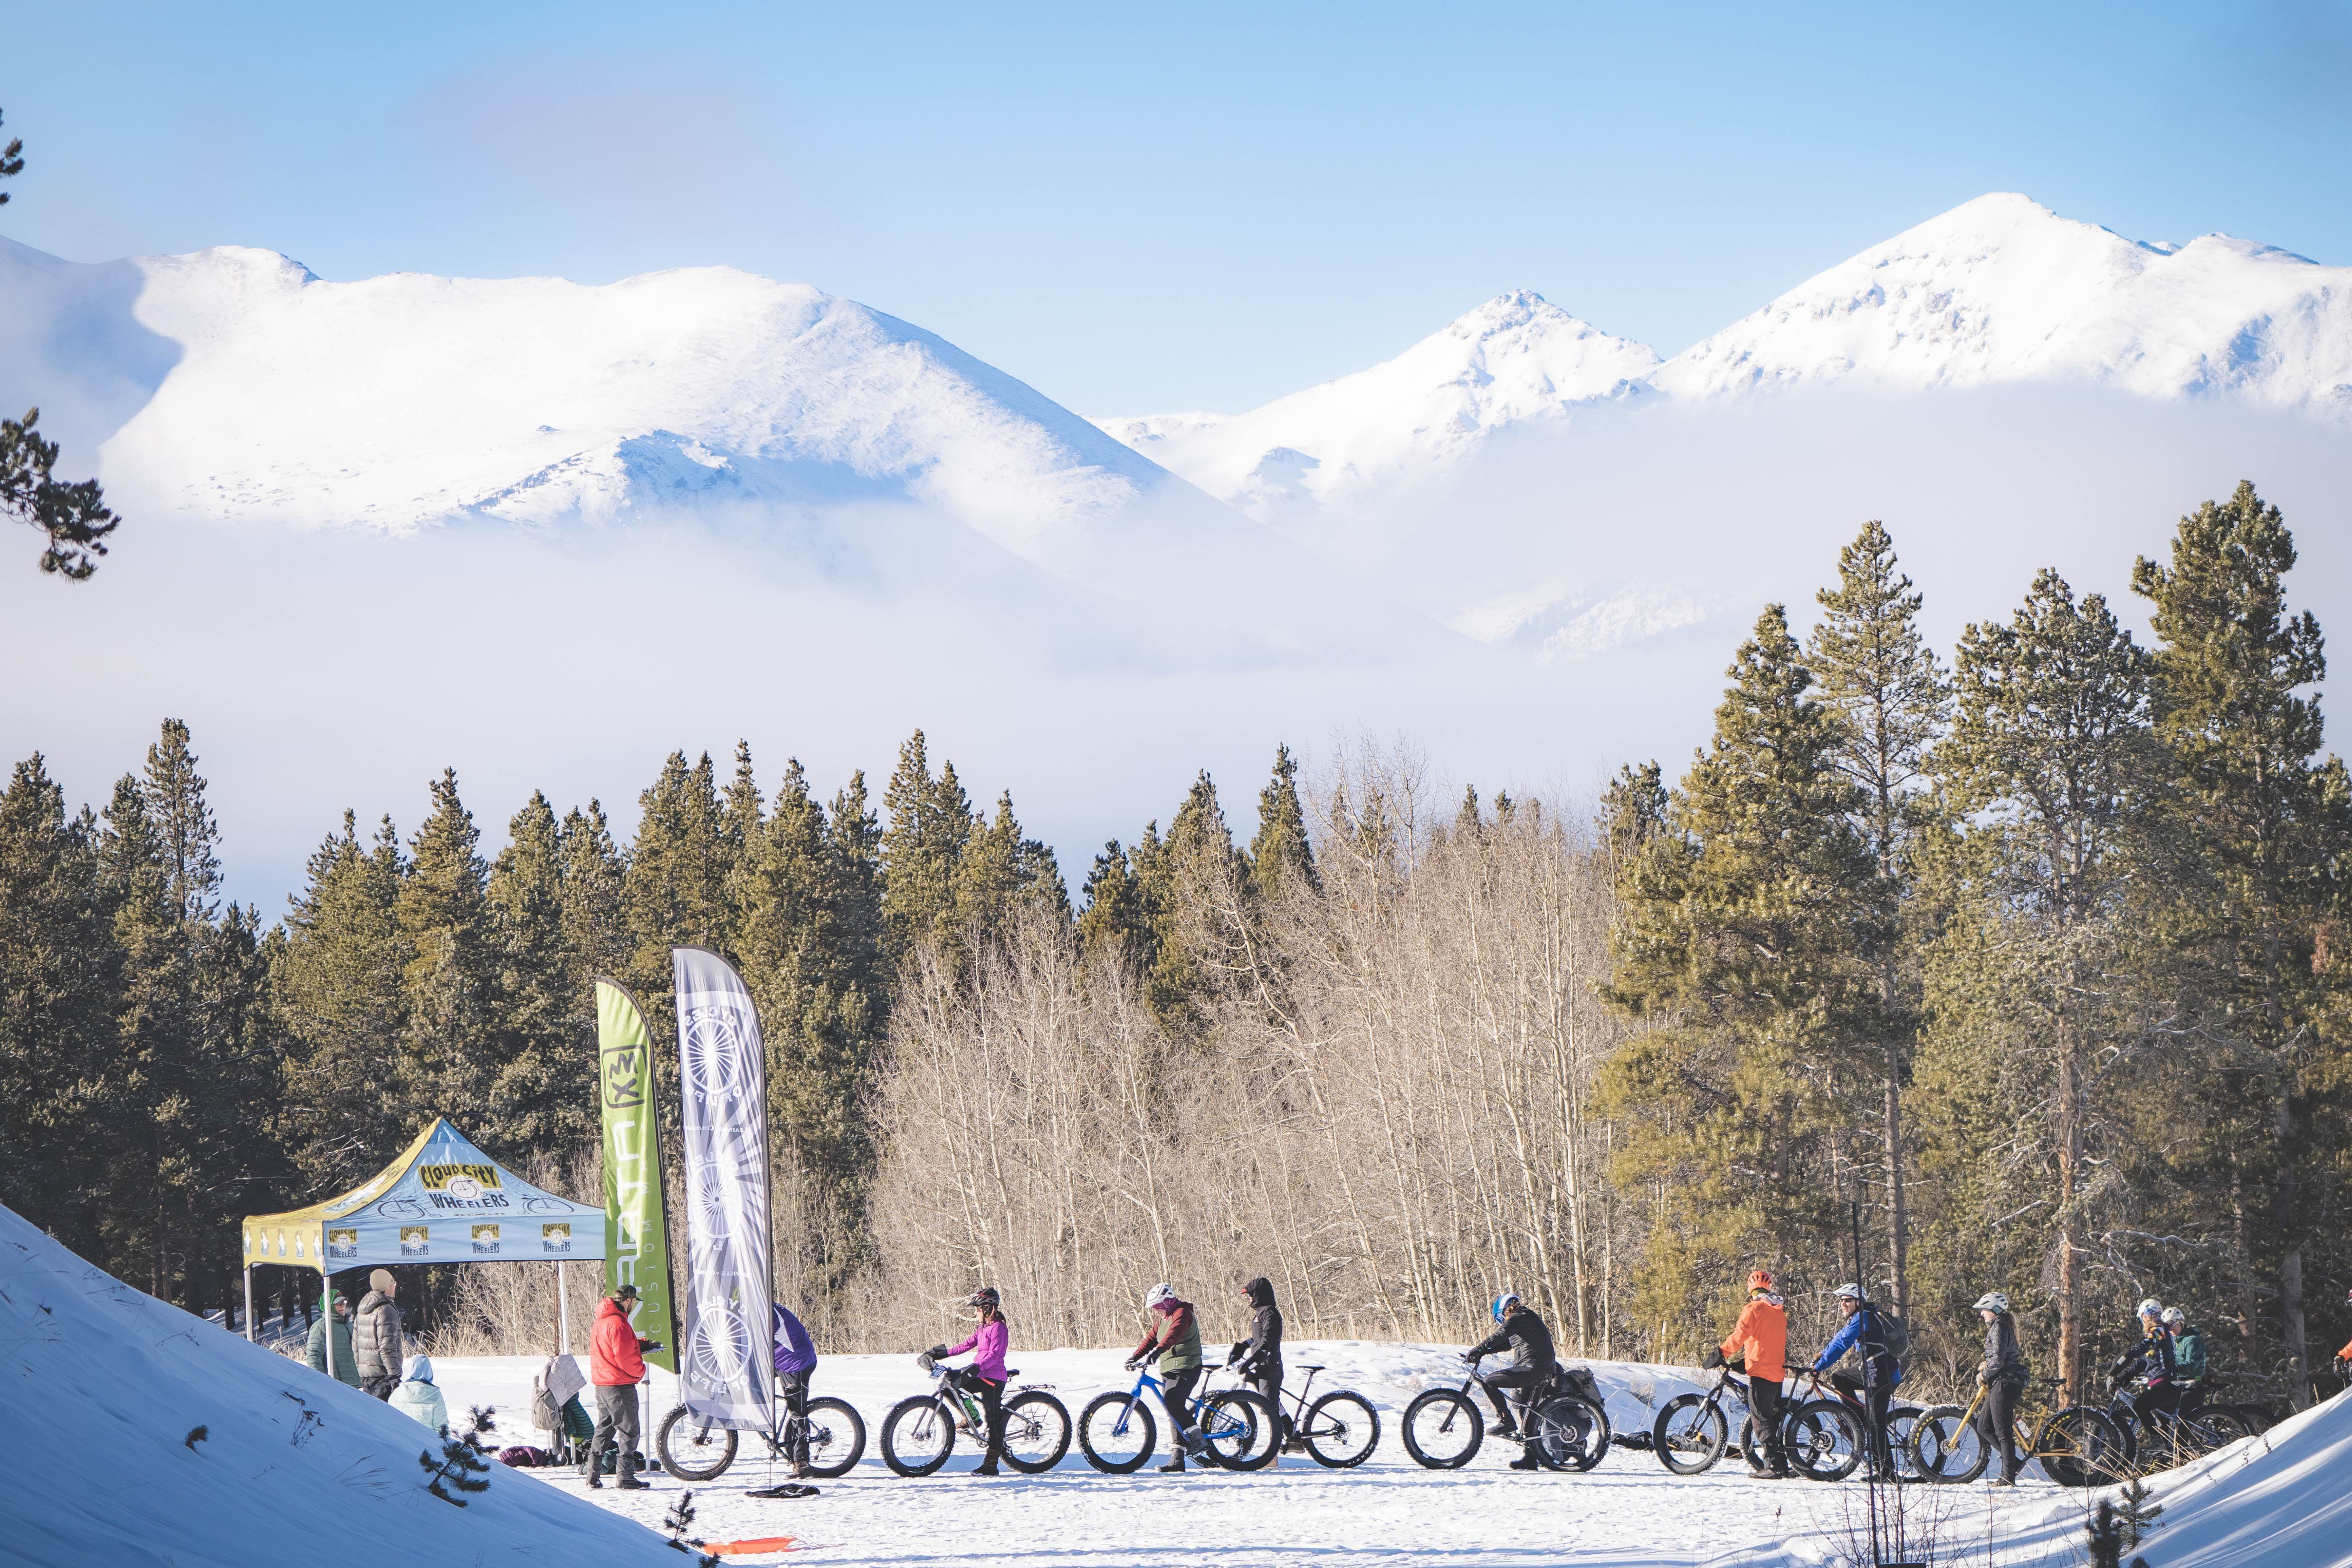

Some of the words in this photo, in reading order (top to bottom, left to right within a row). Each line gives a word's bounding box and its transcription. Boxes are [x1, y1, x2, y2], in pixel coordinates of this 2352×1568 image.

[420, 1165, 459, 1188] CLOUD
[429, 1193, 509, 1208] WHEELERS
[330, 1246, 357, 1258] WHEELERS
[401, 1244, 429, 1256] WHEELERS
[472, 1242, 499, 1254] WHEELERS
[543, 1241, 571, 1252] WHEELERS
[642, 1219, 662, 1334] CUSTOM
